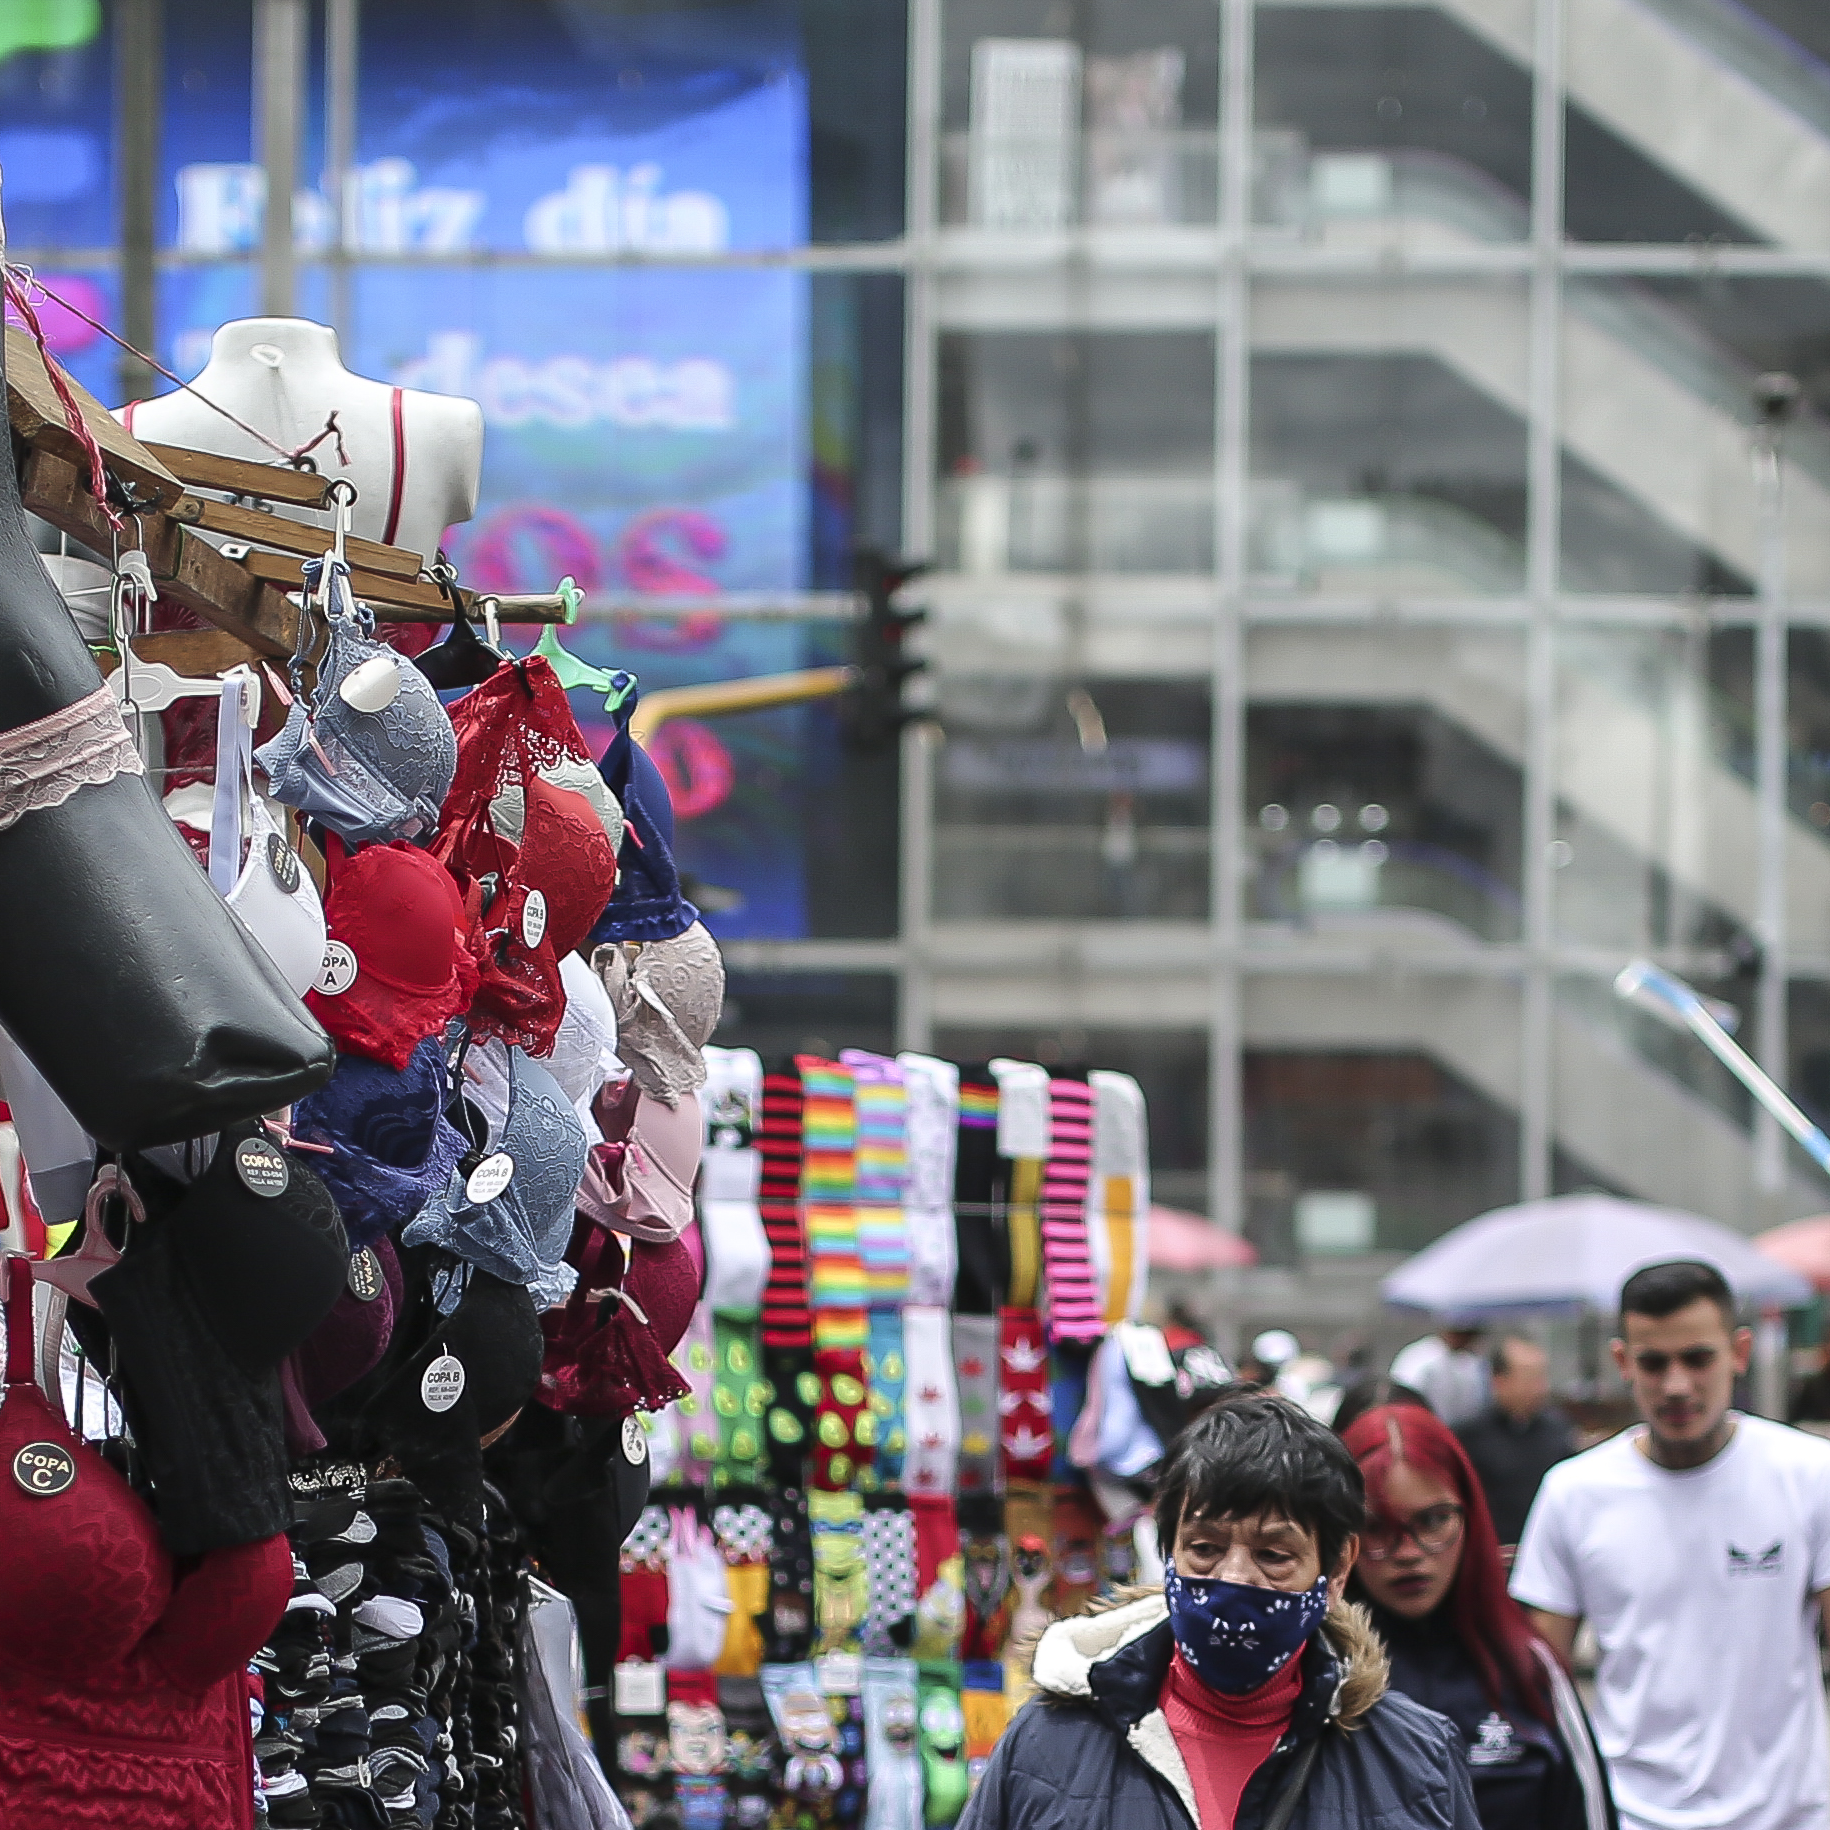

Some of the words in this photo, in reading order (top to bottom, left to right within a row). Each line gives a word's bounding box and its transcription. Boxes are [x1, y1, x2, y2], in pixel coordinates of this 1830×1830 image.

[323, 970, 337, 986] A
[241, 1154, 273, 1169] COPA
[272, 1157, 283, 1170] C
[477, 1168, 499, 1178] COPA
[427, 1371, 451, 1383] COPA
[451, 1371, 461, 1383] B
[21, 1452, 70, 1473] COPA
[32, 1468, 53, 1488] C
